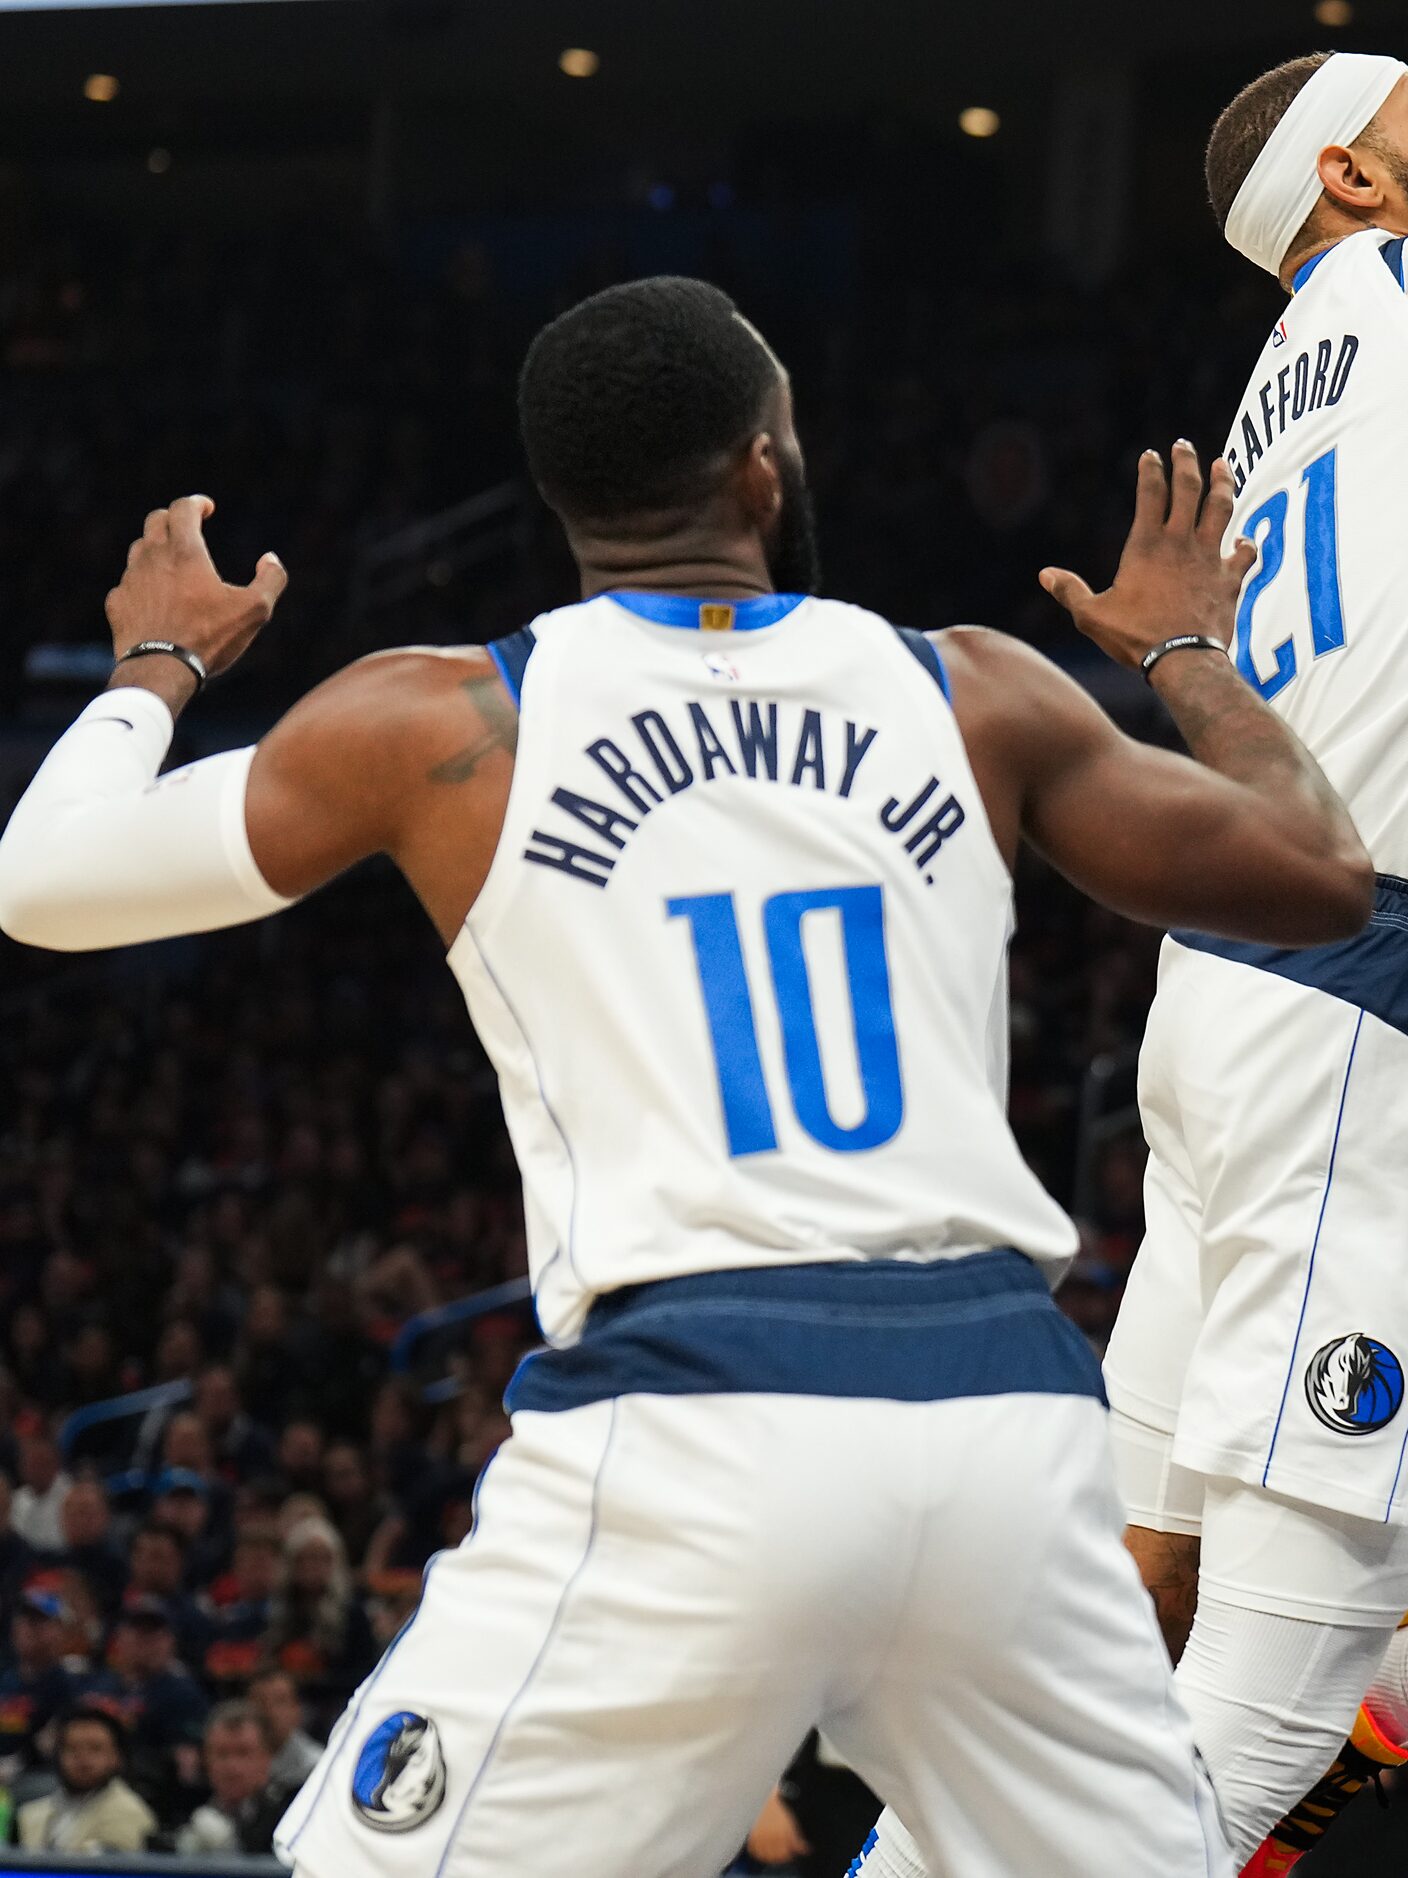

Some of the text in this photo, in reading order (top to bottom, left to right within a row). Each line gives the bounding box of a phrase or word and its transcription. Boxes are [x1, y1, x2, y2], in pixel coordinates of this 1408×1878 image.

[1228, 334, 1359, 498] GAFFORD
[1234, 444, 1348, 704] 21
[523, 700, 966, 888] HARDAWAY JR.
[665, 884, 906, 1158] 10
